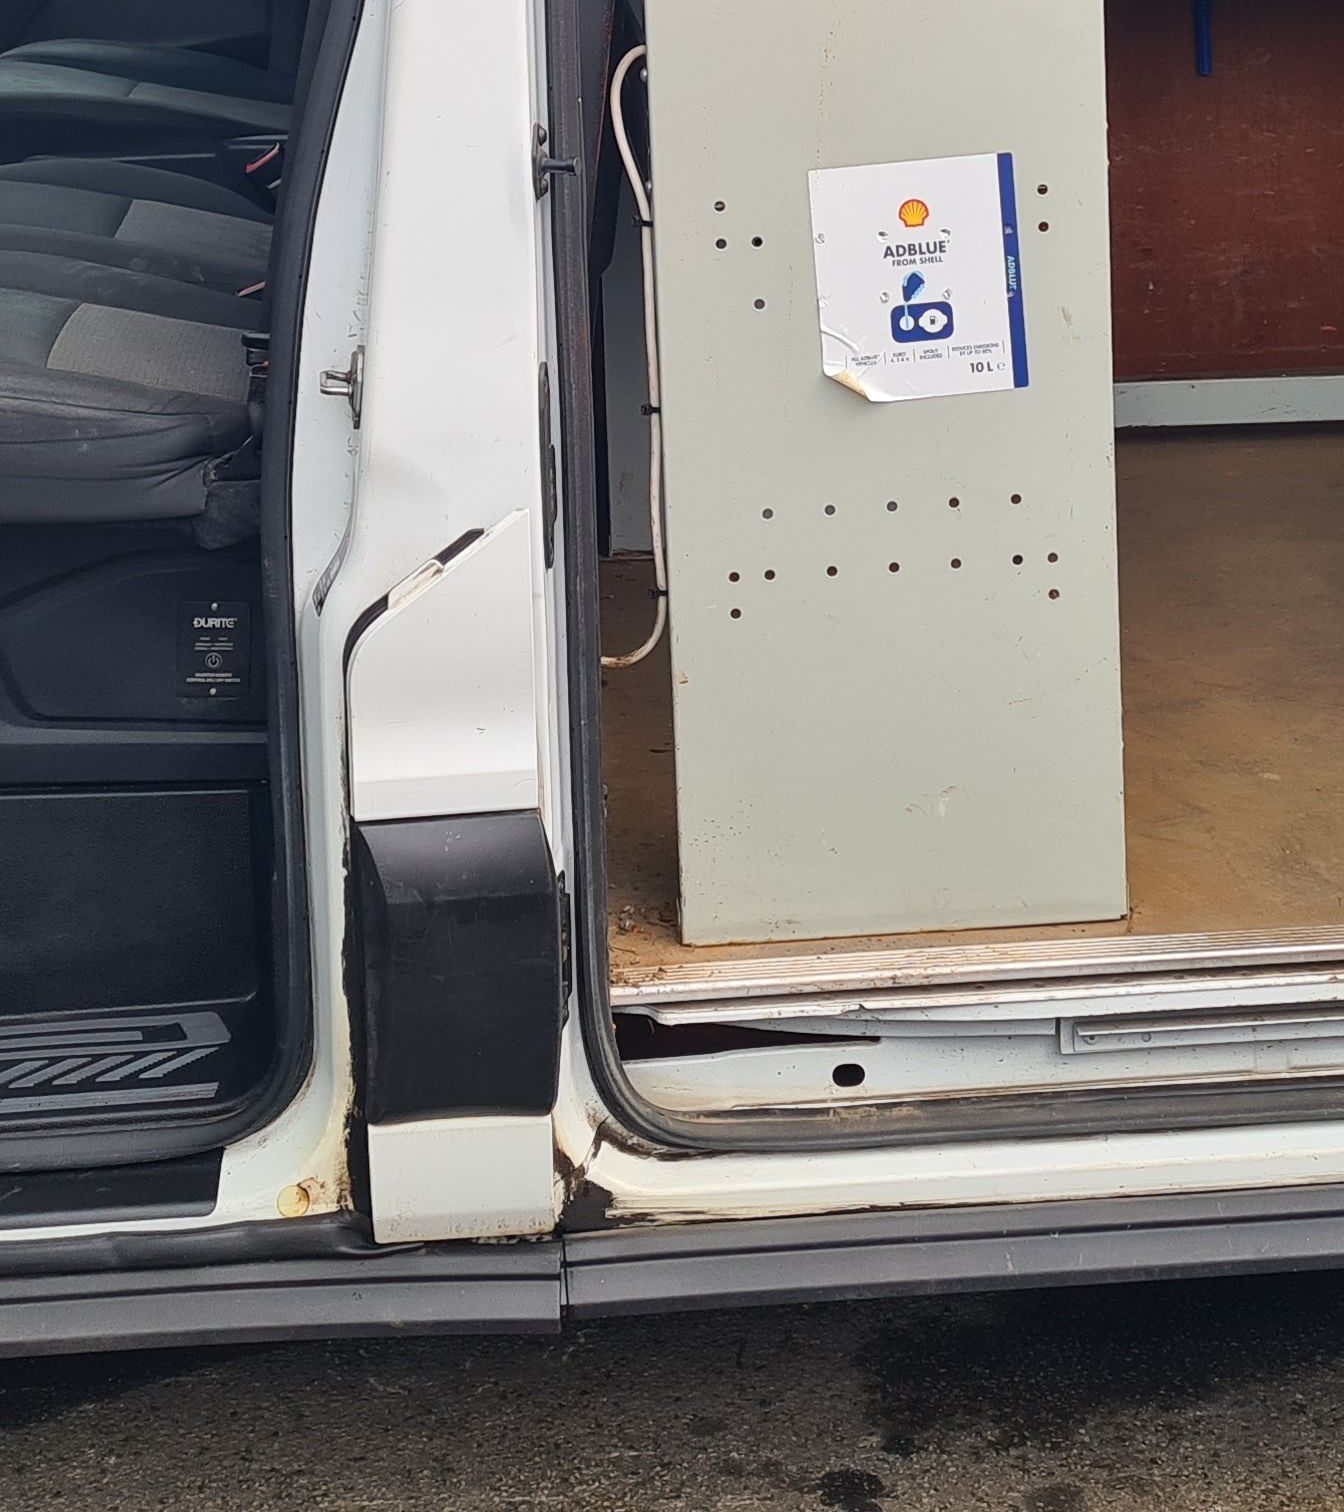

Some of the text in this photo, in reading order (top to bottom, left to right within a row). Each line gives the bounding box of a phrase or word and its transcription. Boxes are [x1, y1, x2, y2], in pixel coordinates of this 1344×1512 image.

[892, 255, 944, 267] FROM SHELL
[969, 361, 994, 374] 10 L
[193, 617, 235, 629] DURITE
